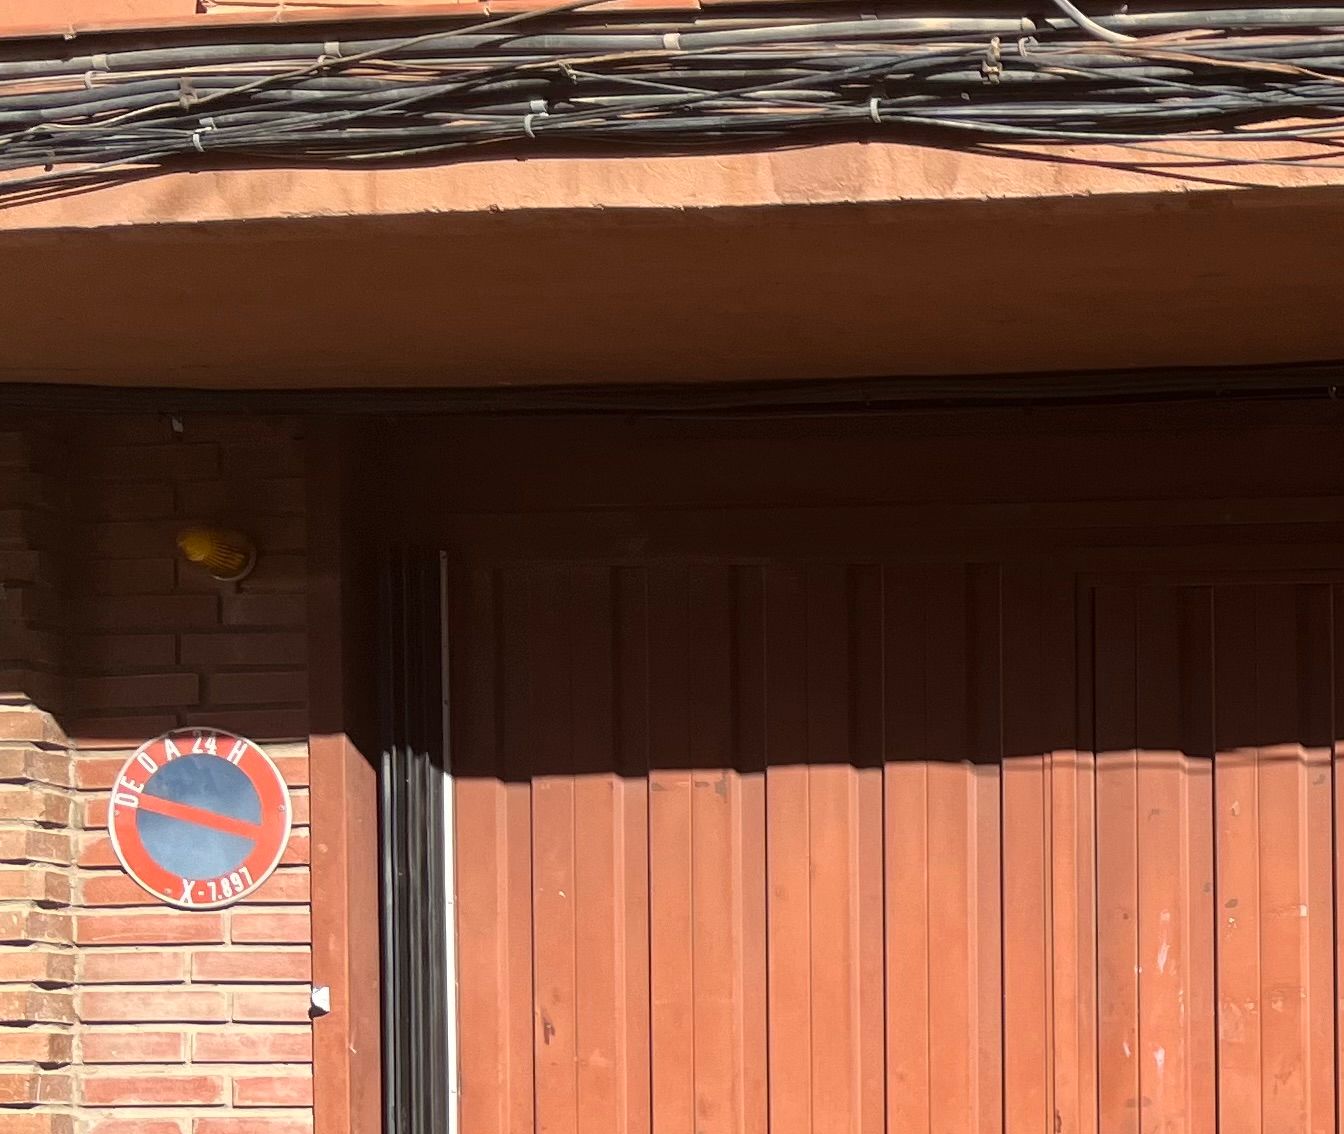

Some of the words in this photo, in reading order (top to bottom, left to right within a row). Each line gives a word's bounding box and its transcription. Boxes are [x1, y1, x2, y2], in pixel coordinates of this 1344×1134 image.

[114, 775, 145, 808] DE
[164, 738, 182, 761] A
[191, 731, 218, 755] 24
[226, 739, 249, 765] H
